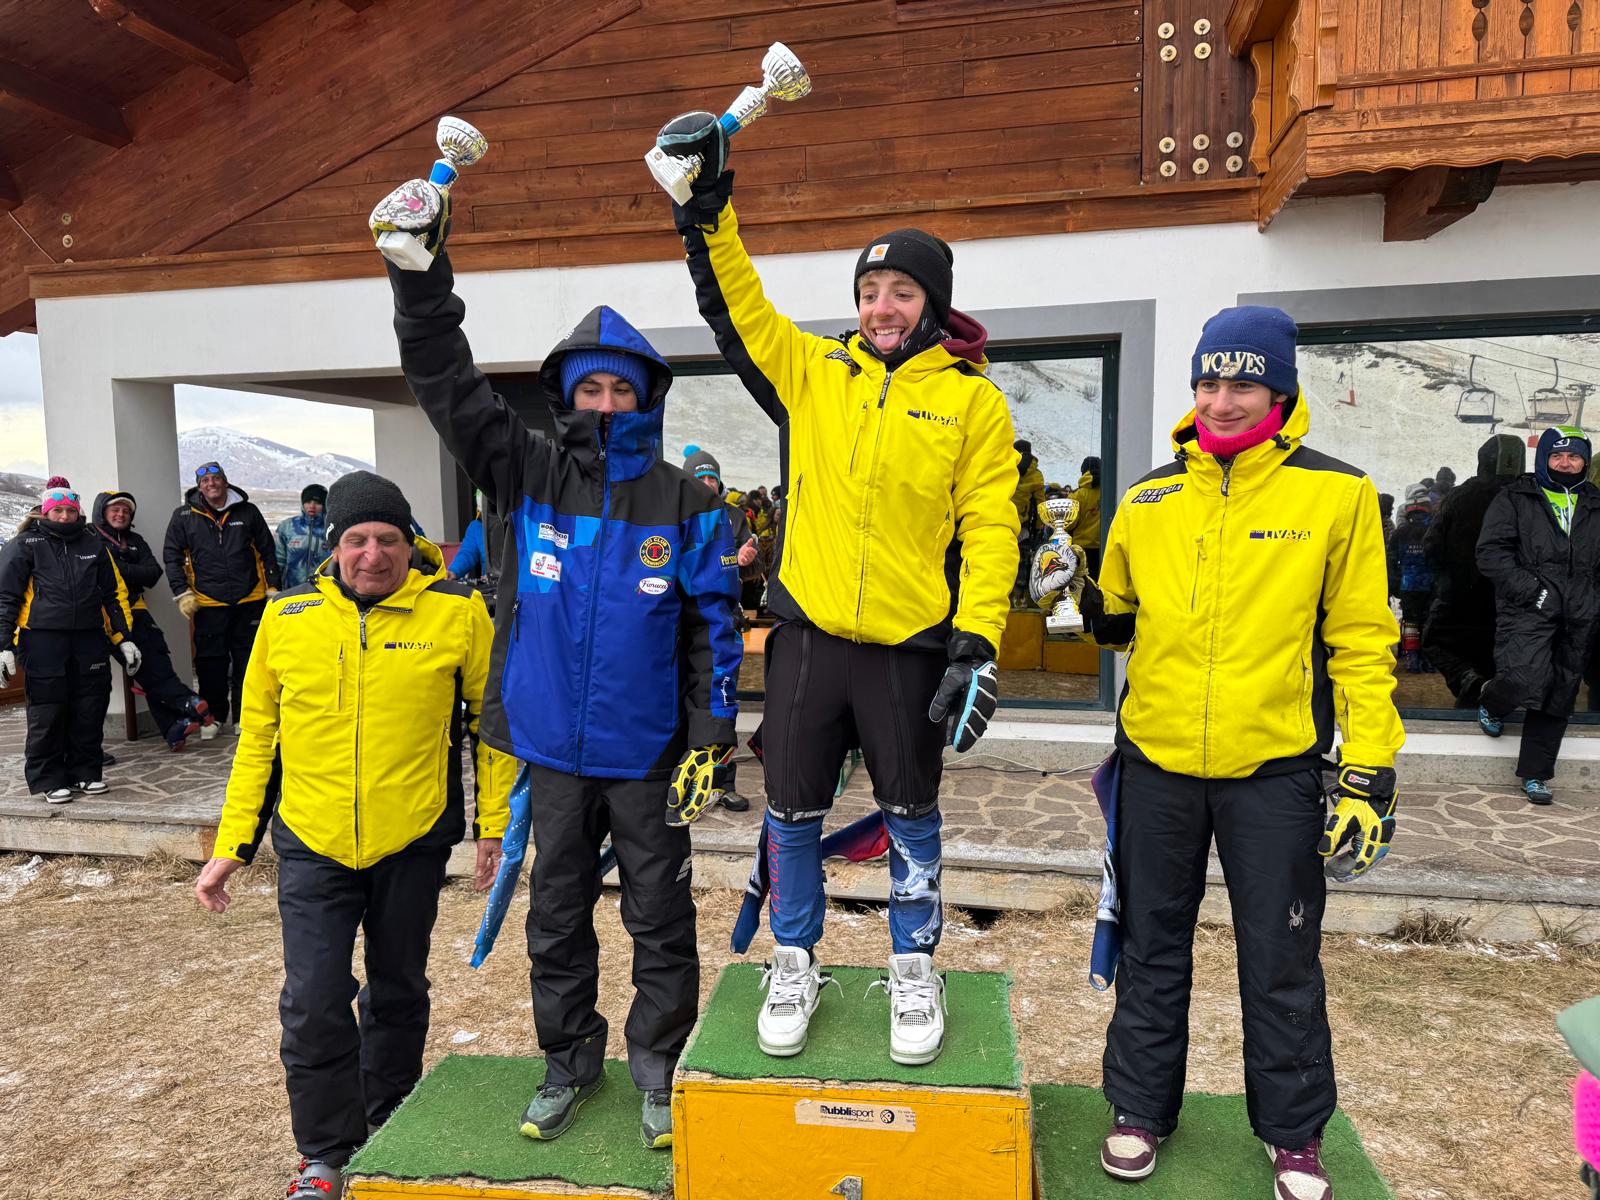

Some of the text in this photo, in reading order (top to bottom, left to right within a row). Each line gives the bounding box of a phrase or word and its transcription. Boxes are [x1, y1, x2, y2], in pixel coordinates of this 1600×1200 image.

[1201, 351, 1266, 376] WOLVES
[1139, 483, 1184, 497] ENERGIA
[1131, 494, 1163, 503] PURA
[1265, 529, 1311, 540] LIVATA
[650, 545, 661, 558] T
[396, 641, 433, 650] LIVATA
